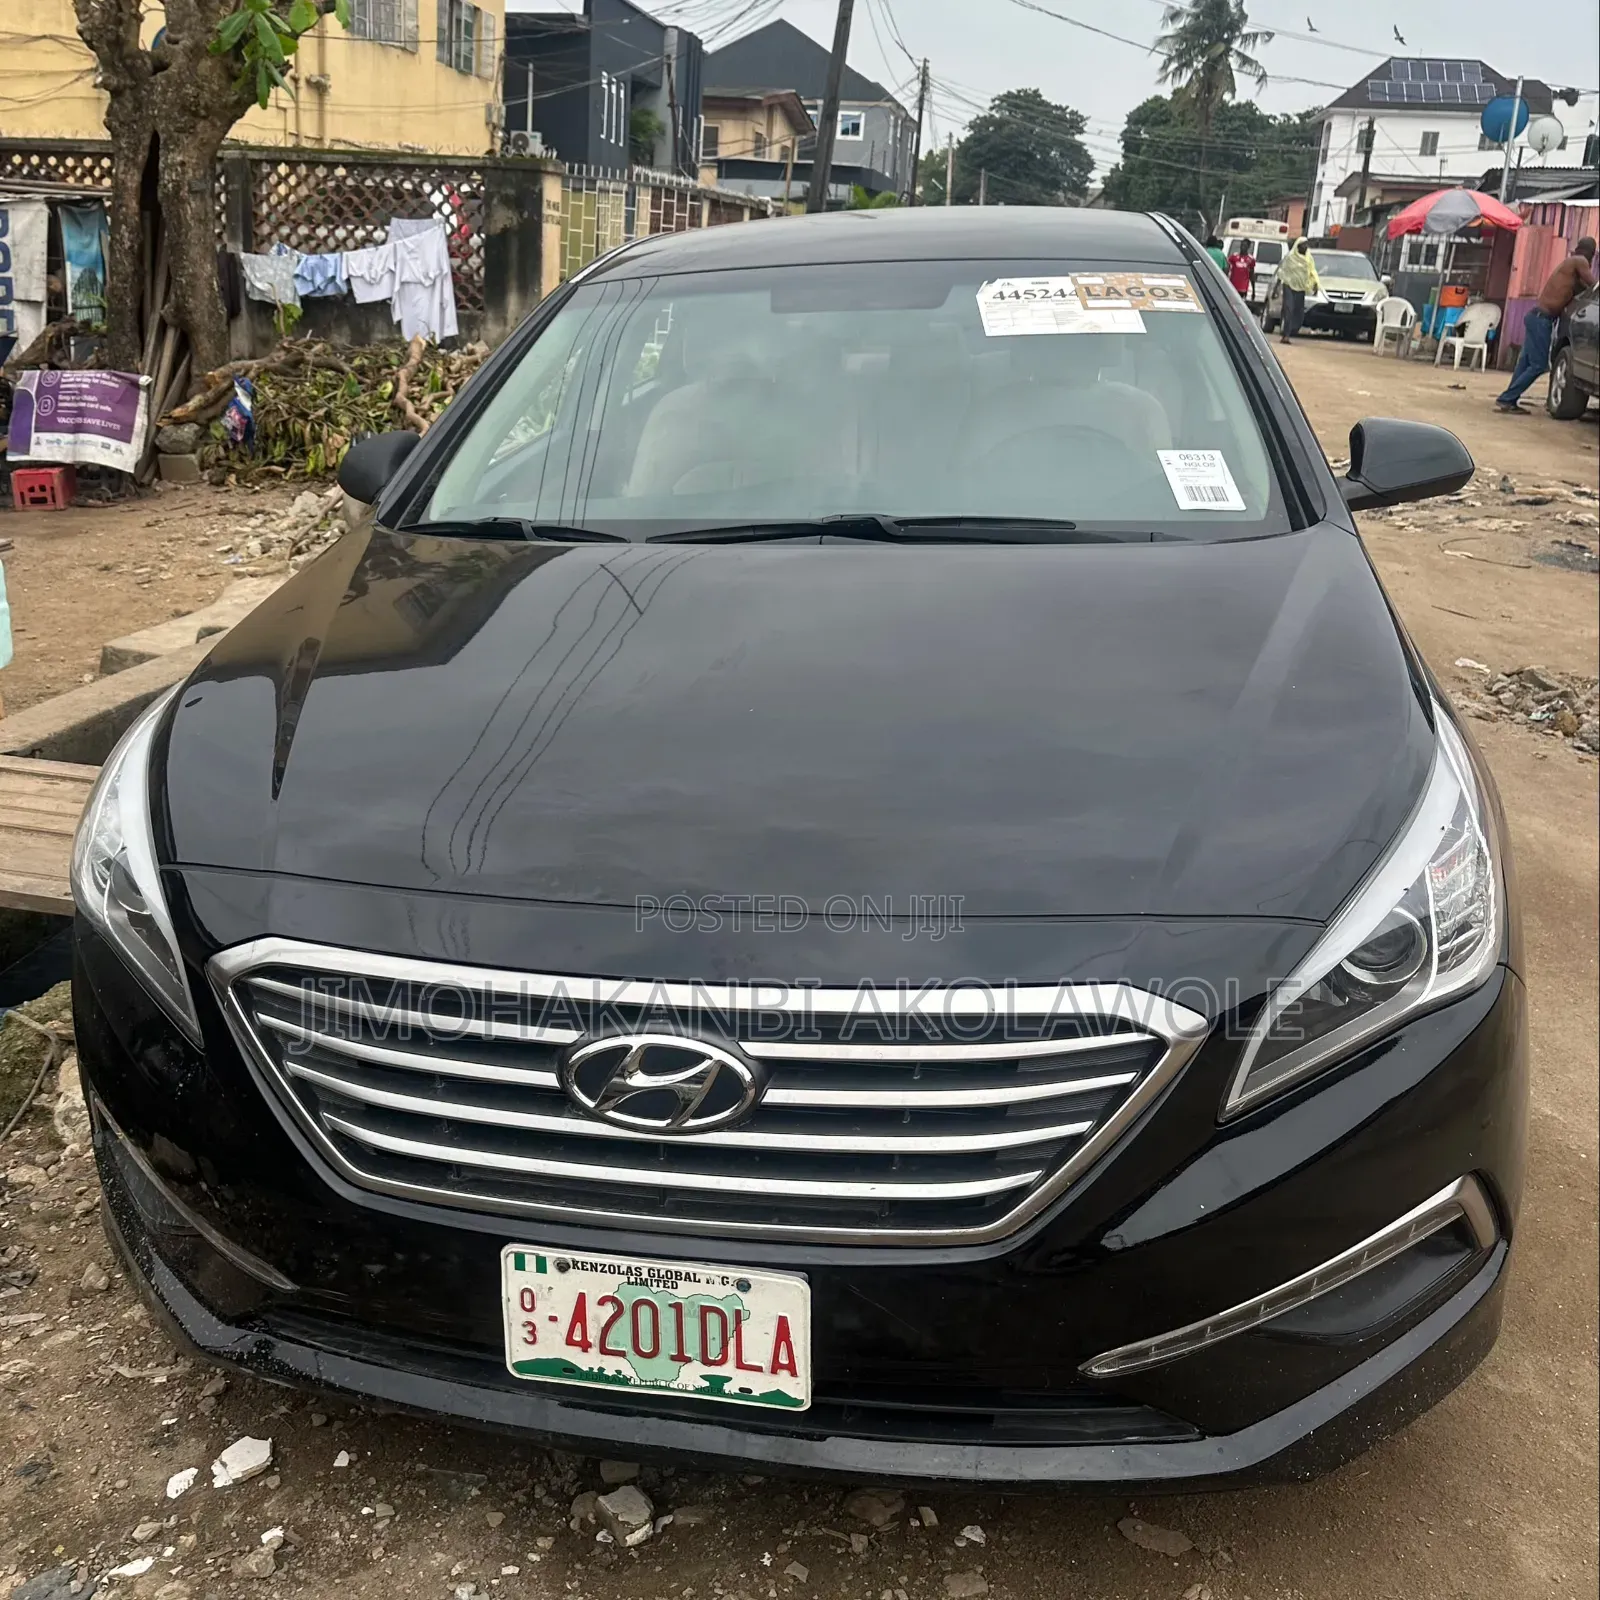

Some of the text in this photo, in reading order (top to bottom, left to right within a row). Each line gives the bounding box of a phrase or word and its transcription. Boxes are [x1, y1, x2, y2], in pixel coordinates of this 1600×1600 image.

[1084, 285, 1189, 299] LAGOS
[1178, 453, 1215, 461] 06313
[571, 1259, 643, 1277] KENZOLAS
[647, 1267, 701, 1284] GLOBAL
[626, 1275, 679, 1290] LIMITED
[676, 1382, 691, 1392] OF
[692, 1383, 735, 1397] NIGERIA
